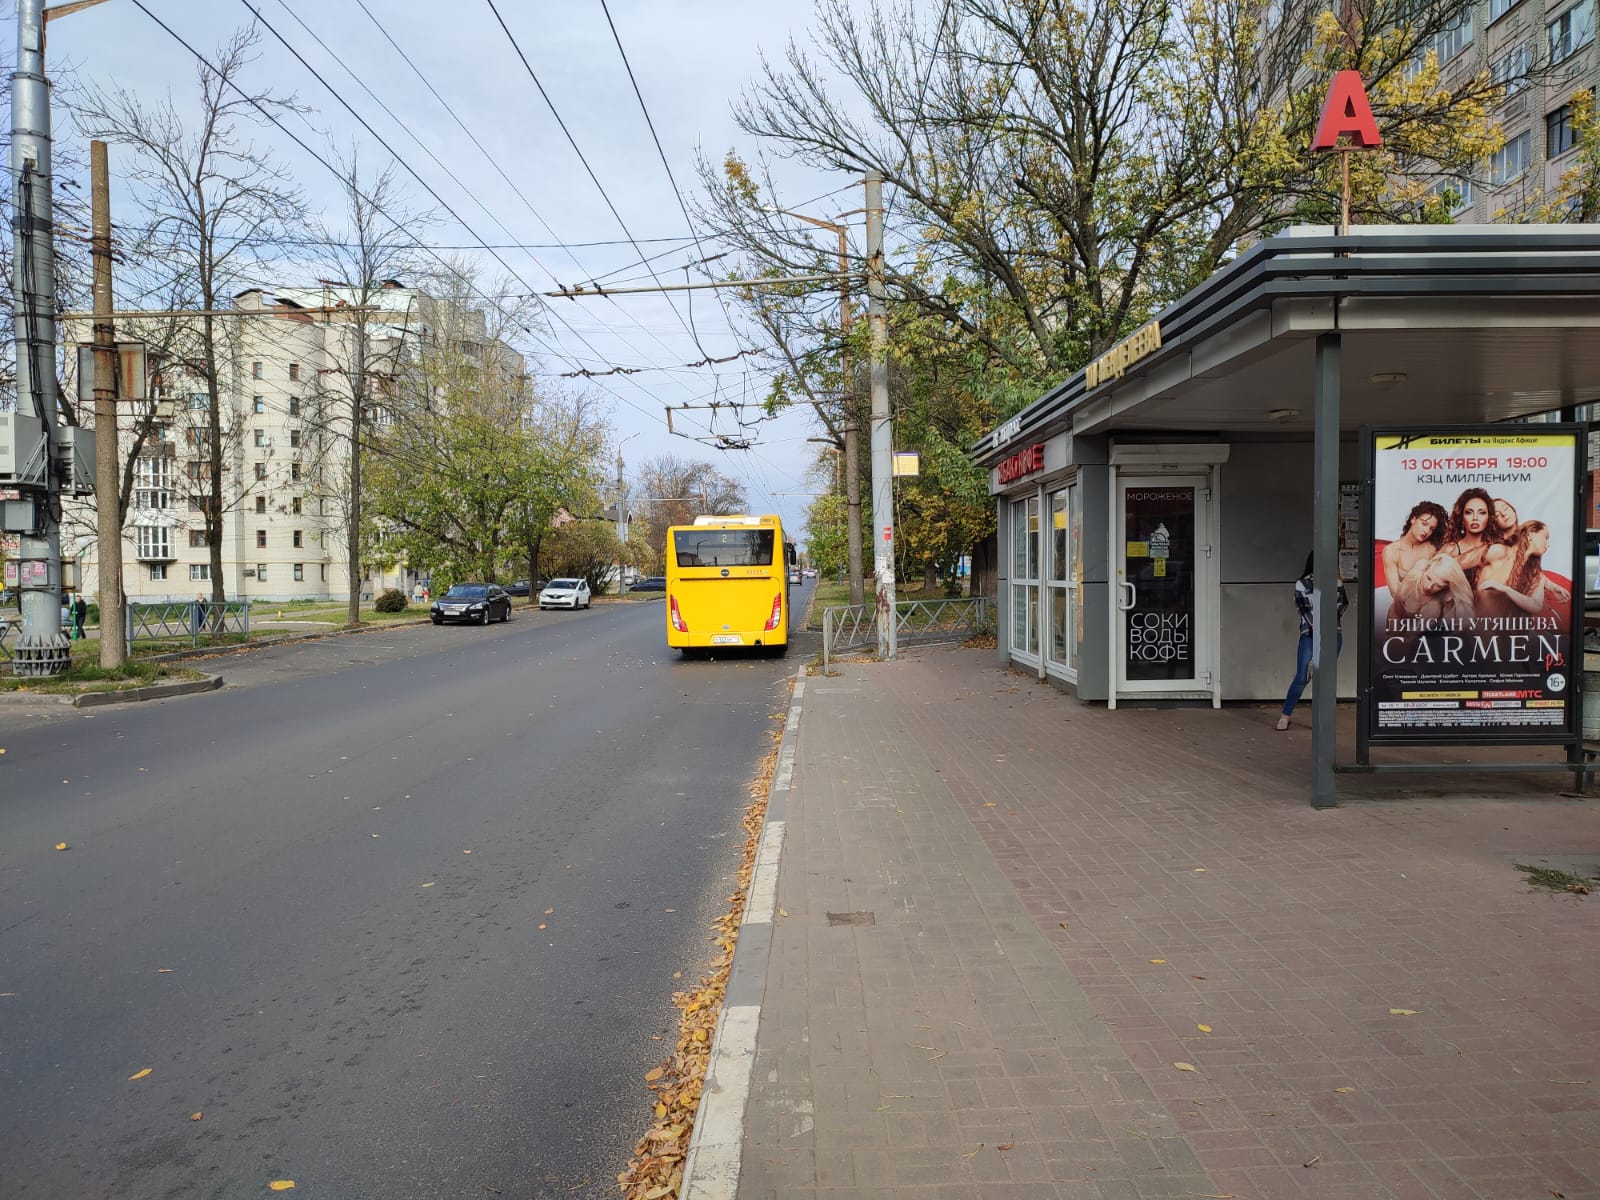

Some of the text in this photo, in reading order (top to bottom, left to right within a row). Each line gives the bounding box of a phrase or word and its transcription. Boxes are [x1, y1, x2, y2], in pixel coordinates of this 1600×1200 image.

[1311, 70, 1382, 150] А
[1401, 457, 1547, 470] 13 ОКТЯБРЯ 19:00
[1417, 473, 1531, 484] КЗЦ МИЛЛЕНИУМ
[1127, 492, 1193, 501] МОРОЖЕНОЕ
[721, 534, 727, 543] 2
[1131, 613, 1188, 629] СОКИ
[1385, 613, 1559, 632] ЛЯЙСАН УТЯШЕВА
[1130, 628, 1188, 646] ВОДЫ
[1130, 644, 1188, 660] КОФЕ
[1382, 635, 1564, 666] CARMEN
[1550, 677, 1564, 688] 16+
[1517, 690, 1543, 698] МТС
